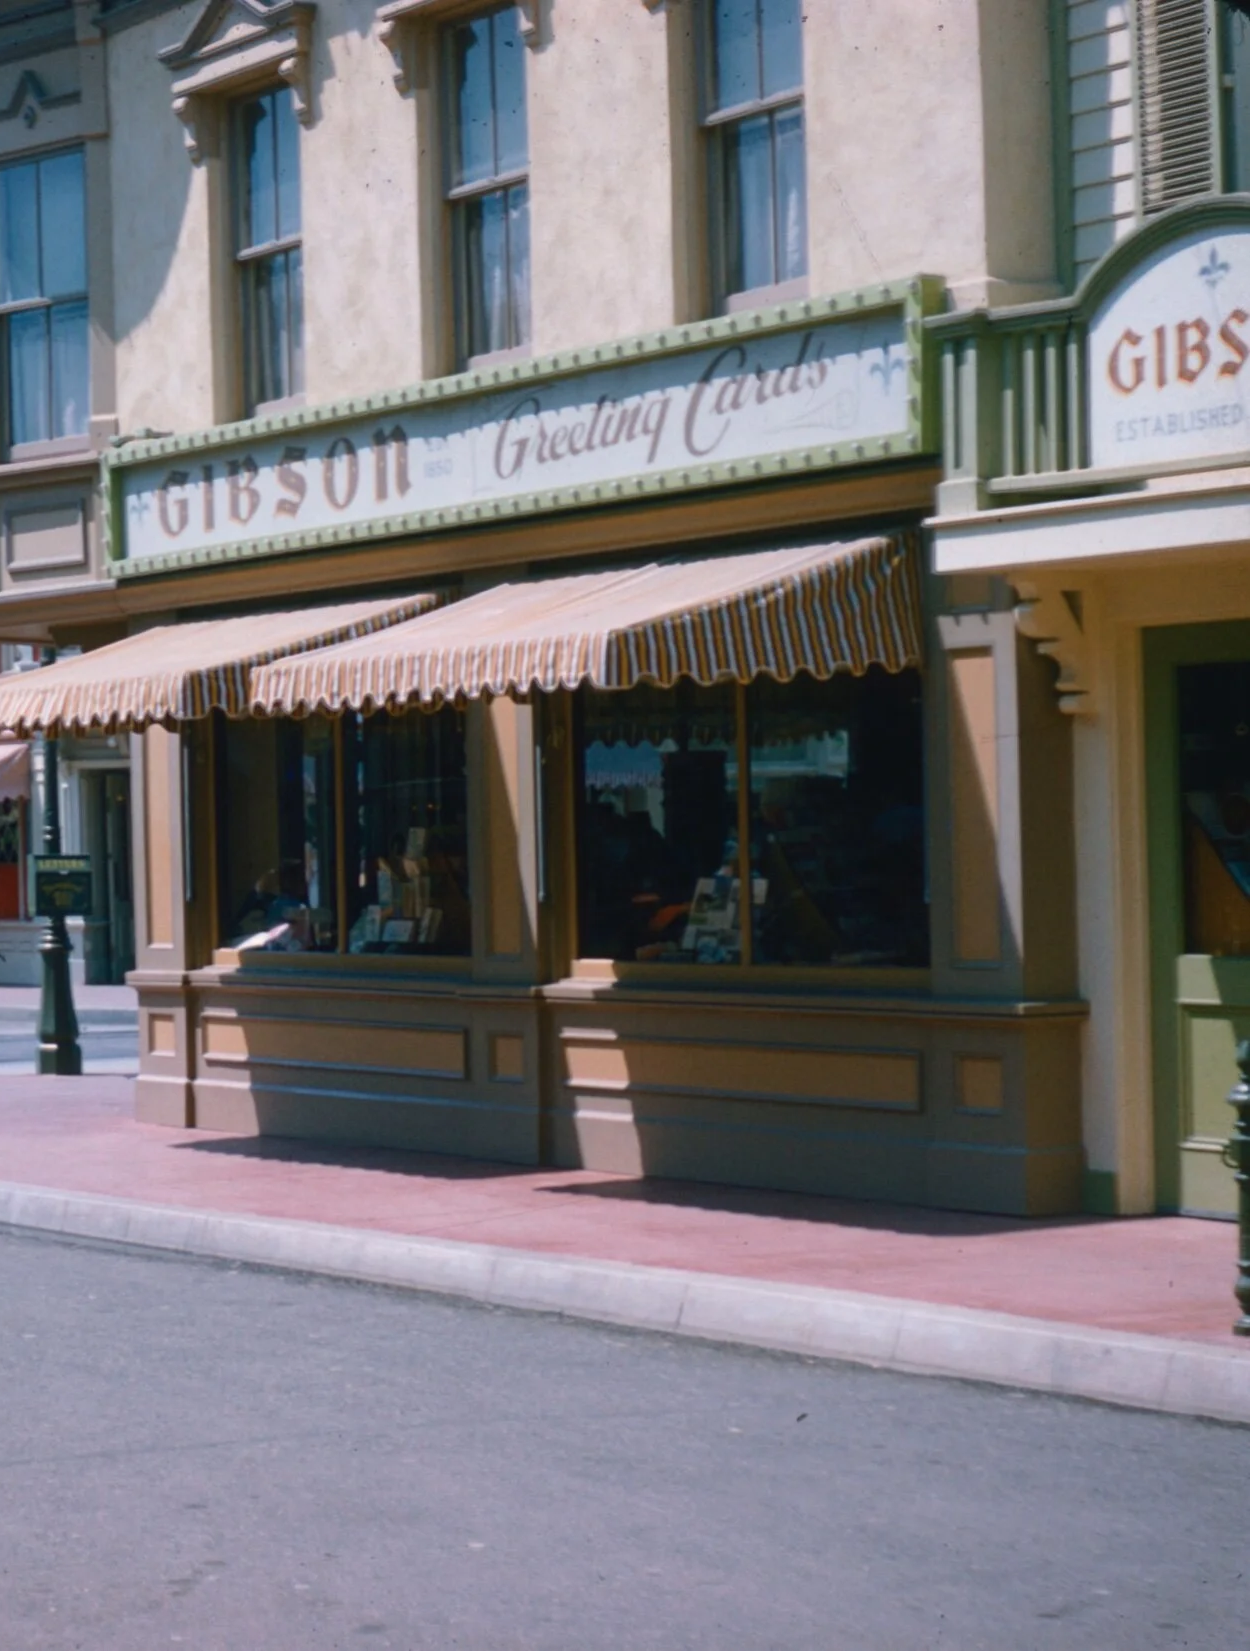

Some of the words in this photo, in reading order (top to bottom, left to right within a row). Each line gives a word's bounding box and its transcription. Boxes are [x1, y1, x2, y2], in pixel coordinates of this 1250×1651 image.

[1107, 308, 1250, 396] GIBS
[494, 396, 671, 480] Greeting
[684, 330, 828, 457] Cards
[1116, 403, 1244, 443] ESTABLISHED
